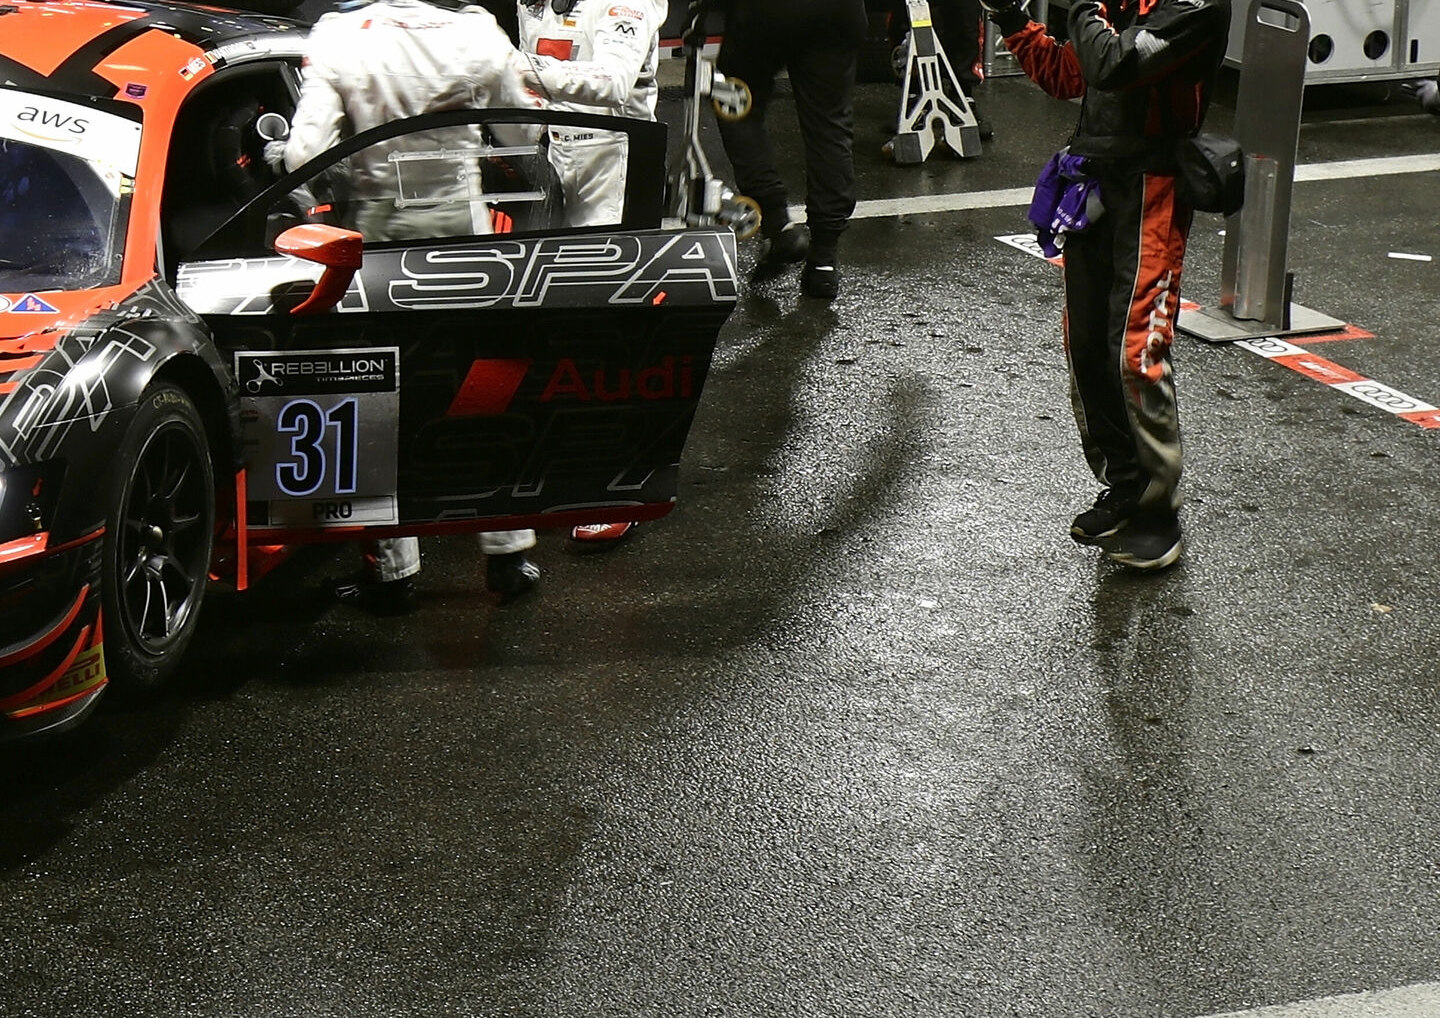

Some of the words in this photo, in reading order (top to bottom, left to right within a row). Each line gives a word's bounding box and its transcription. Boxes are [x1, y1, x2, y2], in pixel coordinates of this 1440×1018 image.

[16, 103, 90, 135] aws
[574, 133, 594, 141] MIES
[389, 228, 738, 310] SPA
[271, 359, 385, 375] REBELLION
[540, 356, 693, 401] Audi
[275, 397, 359, 497] 31
[312, 501, 353, 520] PRO
